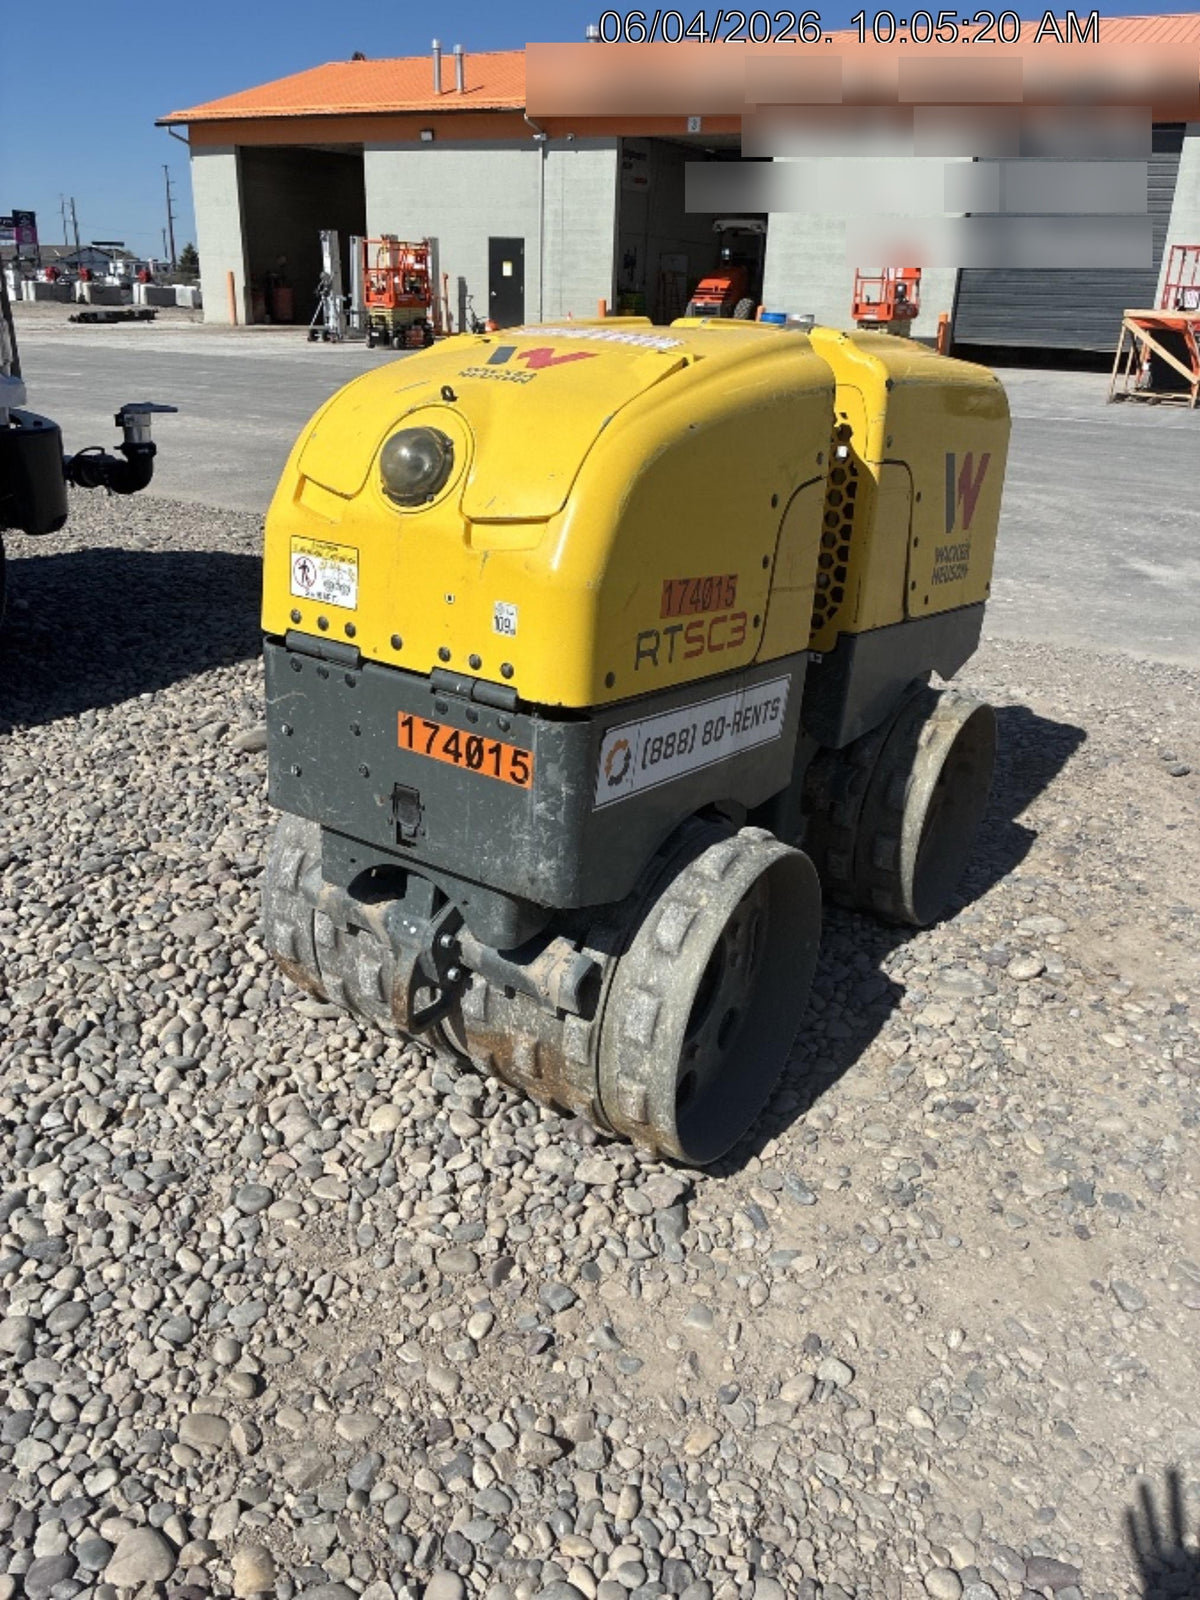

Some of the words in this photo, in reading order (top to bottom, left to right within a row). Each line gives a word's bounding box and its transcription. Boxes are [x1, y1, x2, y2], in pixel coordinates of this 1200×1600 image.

[664, 573, 738, 617] 174015
[634, 611, 748, 671] RTSC3
[702, 697, 781, 747] 80-RENTS
[401, 715, 530, 785] 174015
